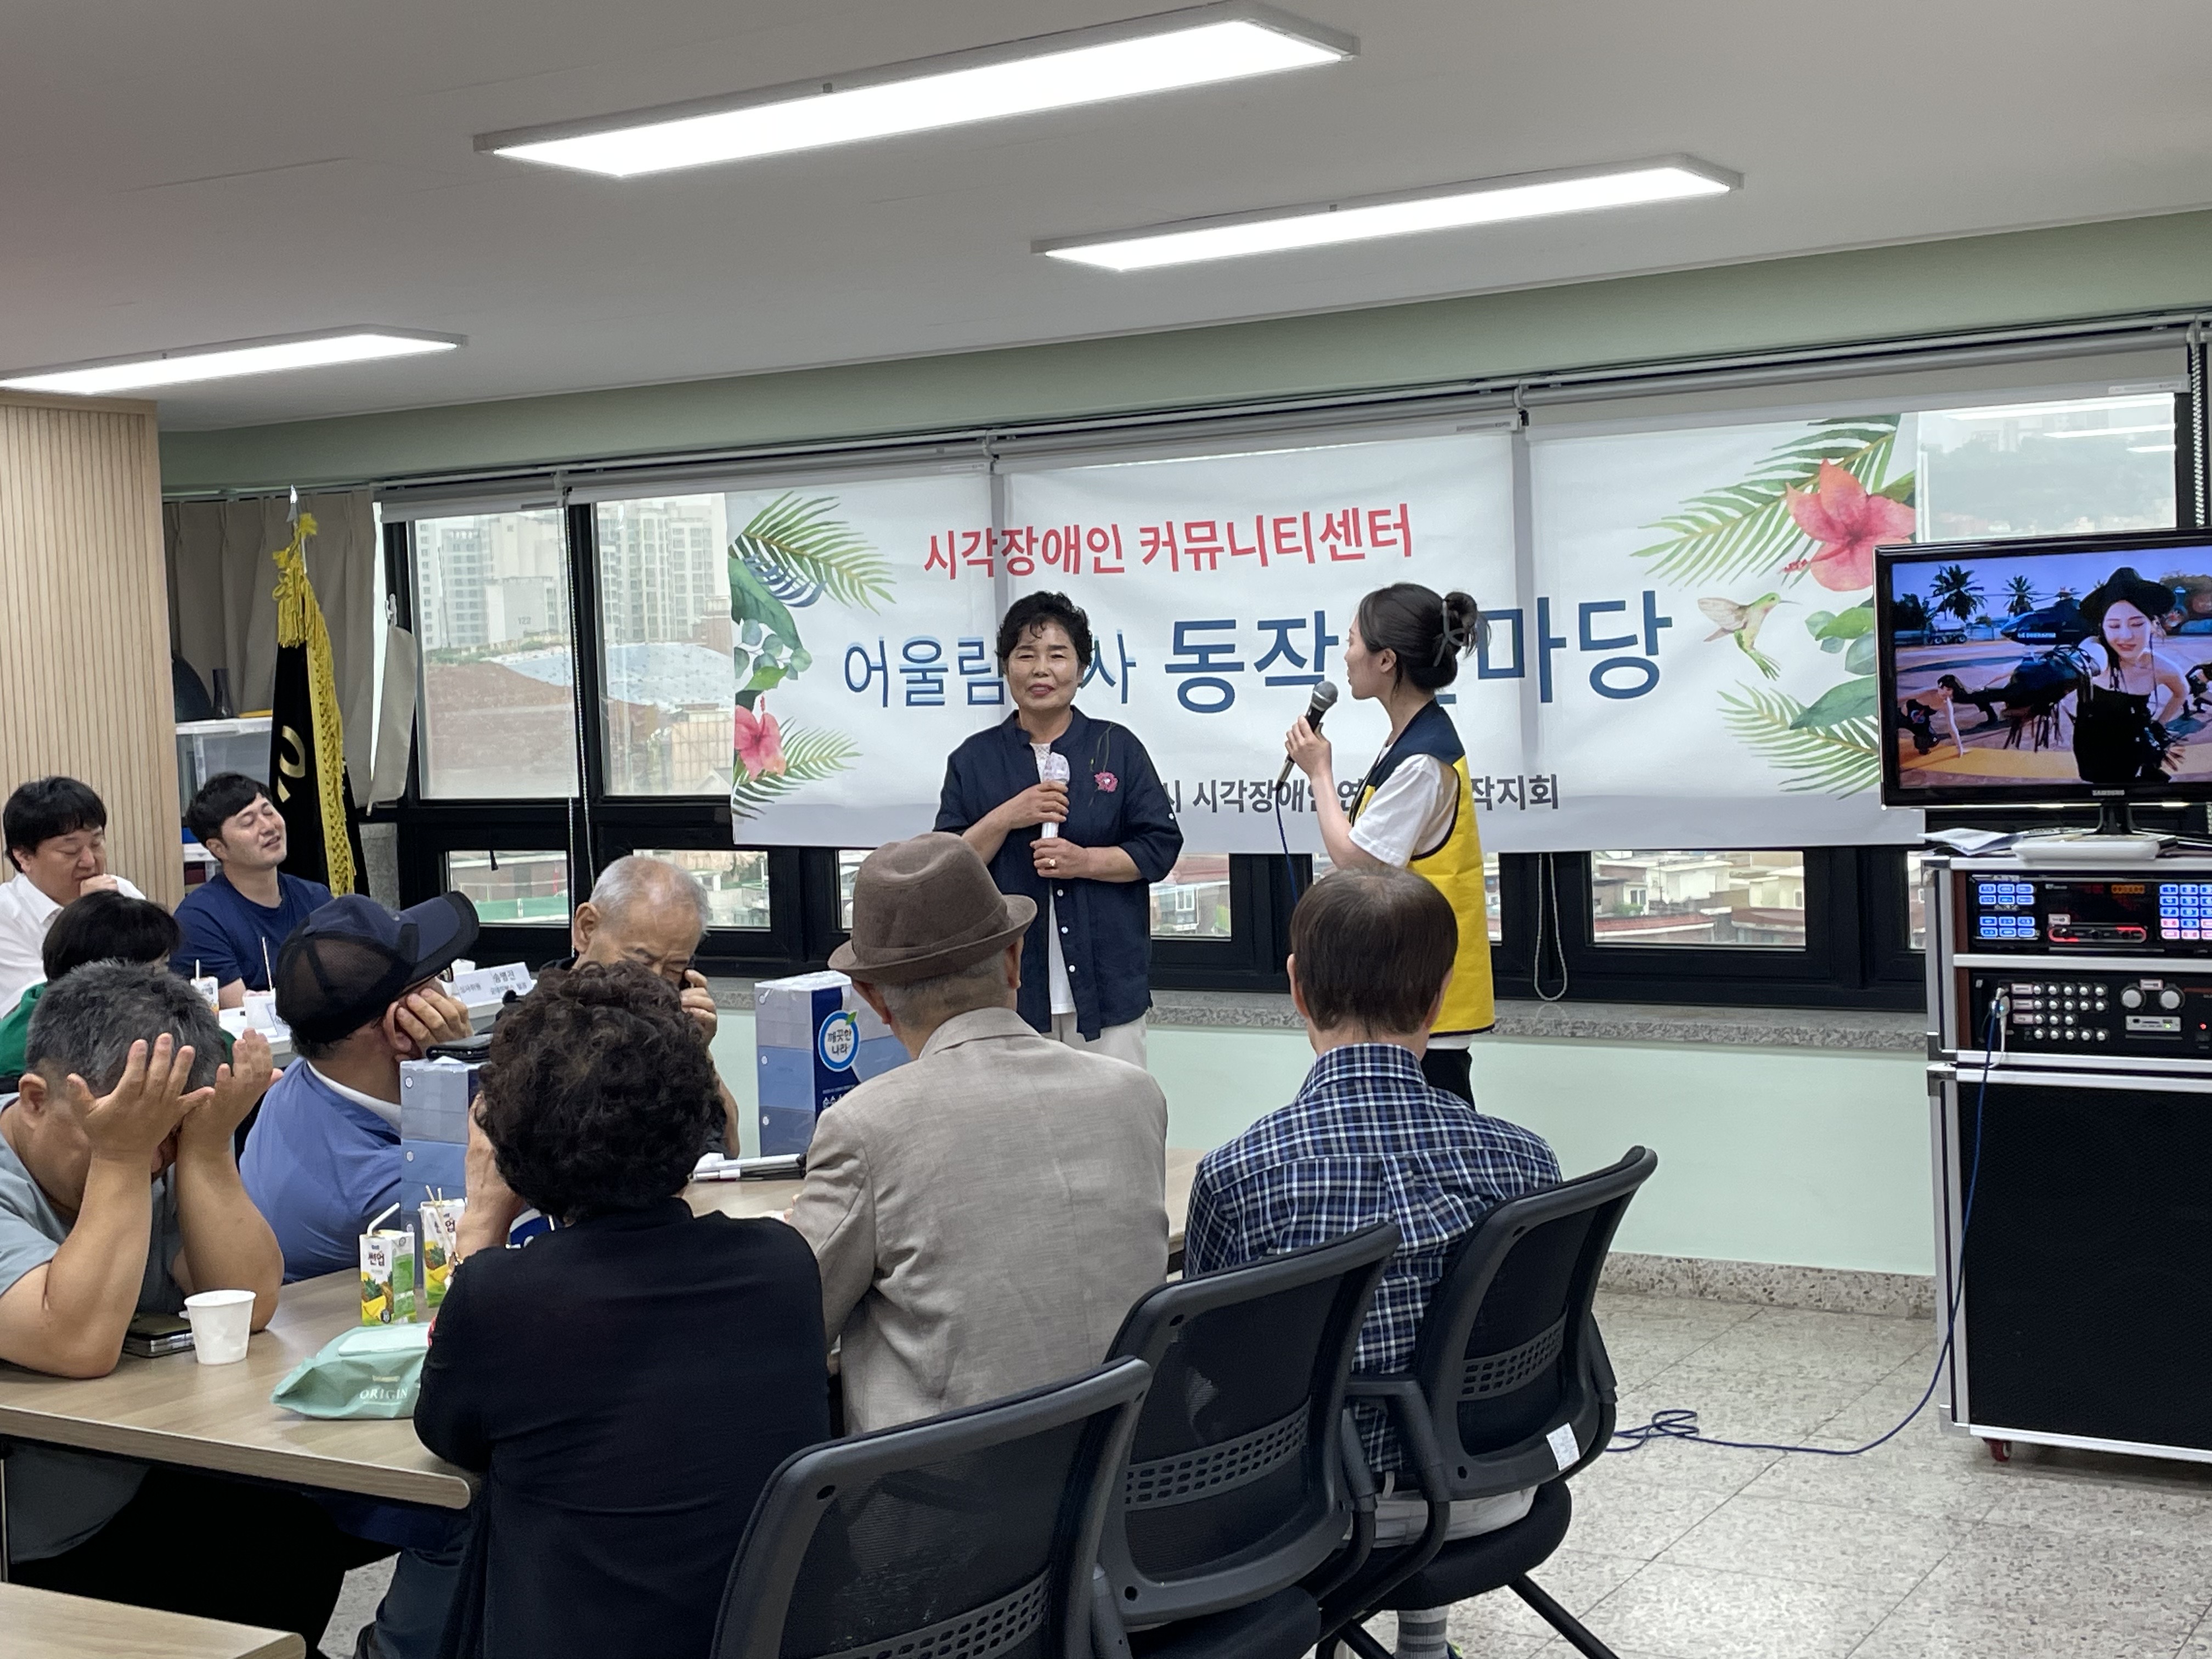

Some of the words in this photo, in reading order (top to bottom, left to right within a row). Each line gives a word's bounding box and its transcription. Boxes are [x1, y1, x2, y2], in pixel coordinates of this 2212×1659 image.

[924, 523, 1125, 579] 시각장애인
[1139, 503, 1412, 572] 커뮤니티센터
[844, 635, 1005, 708] 어울림
[1165, 610, 1339, 713] 동작
[1436, 590, 1673, 703] 마당
[827, 1029, 851, 1043] 깨끗한
[832, 1043, 849, 1056] 나라
[359, 1388, 408, 1400] ORIGIN
